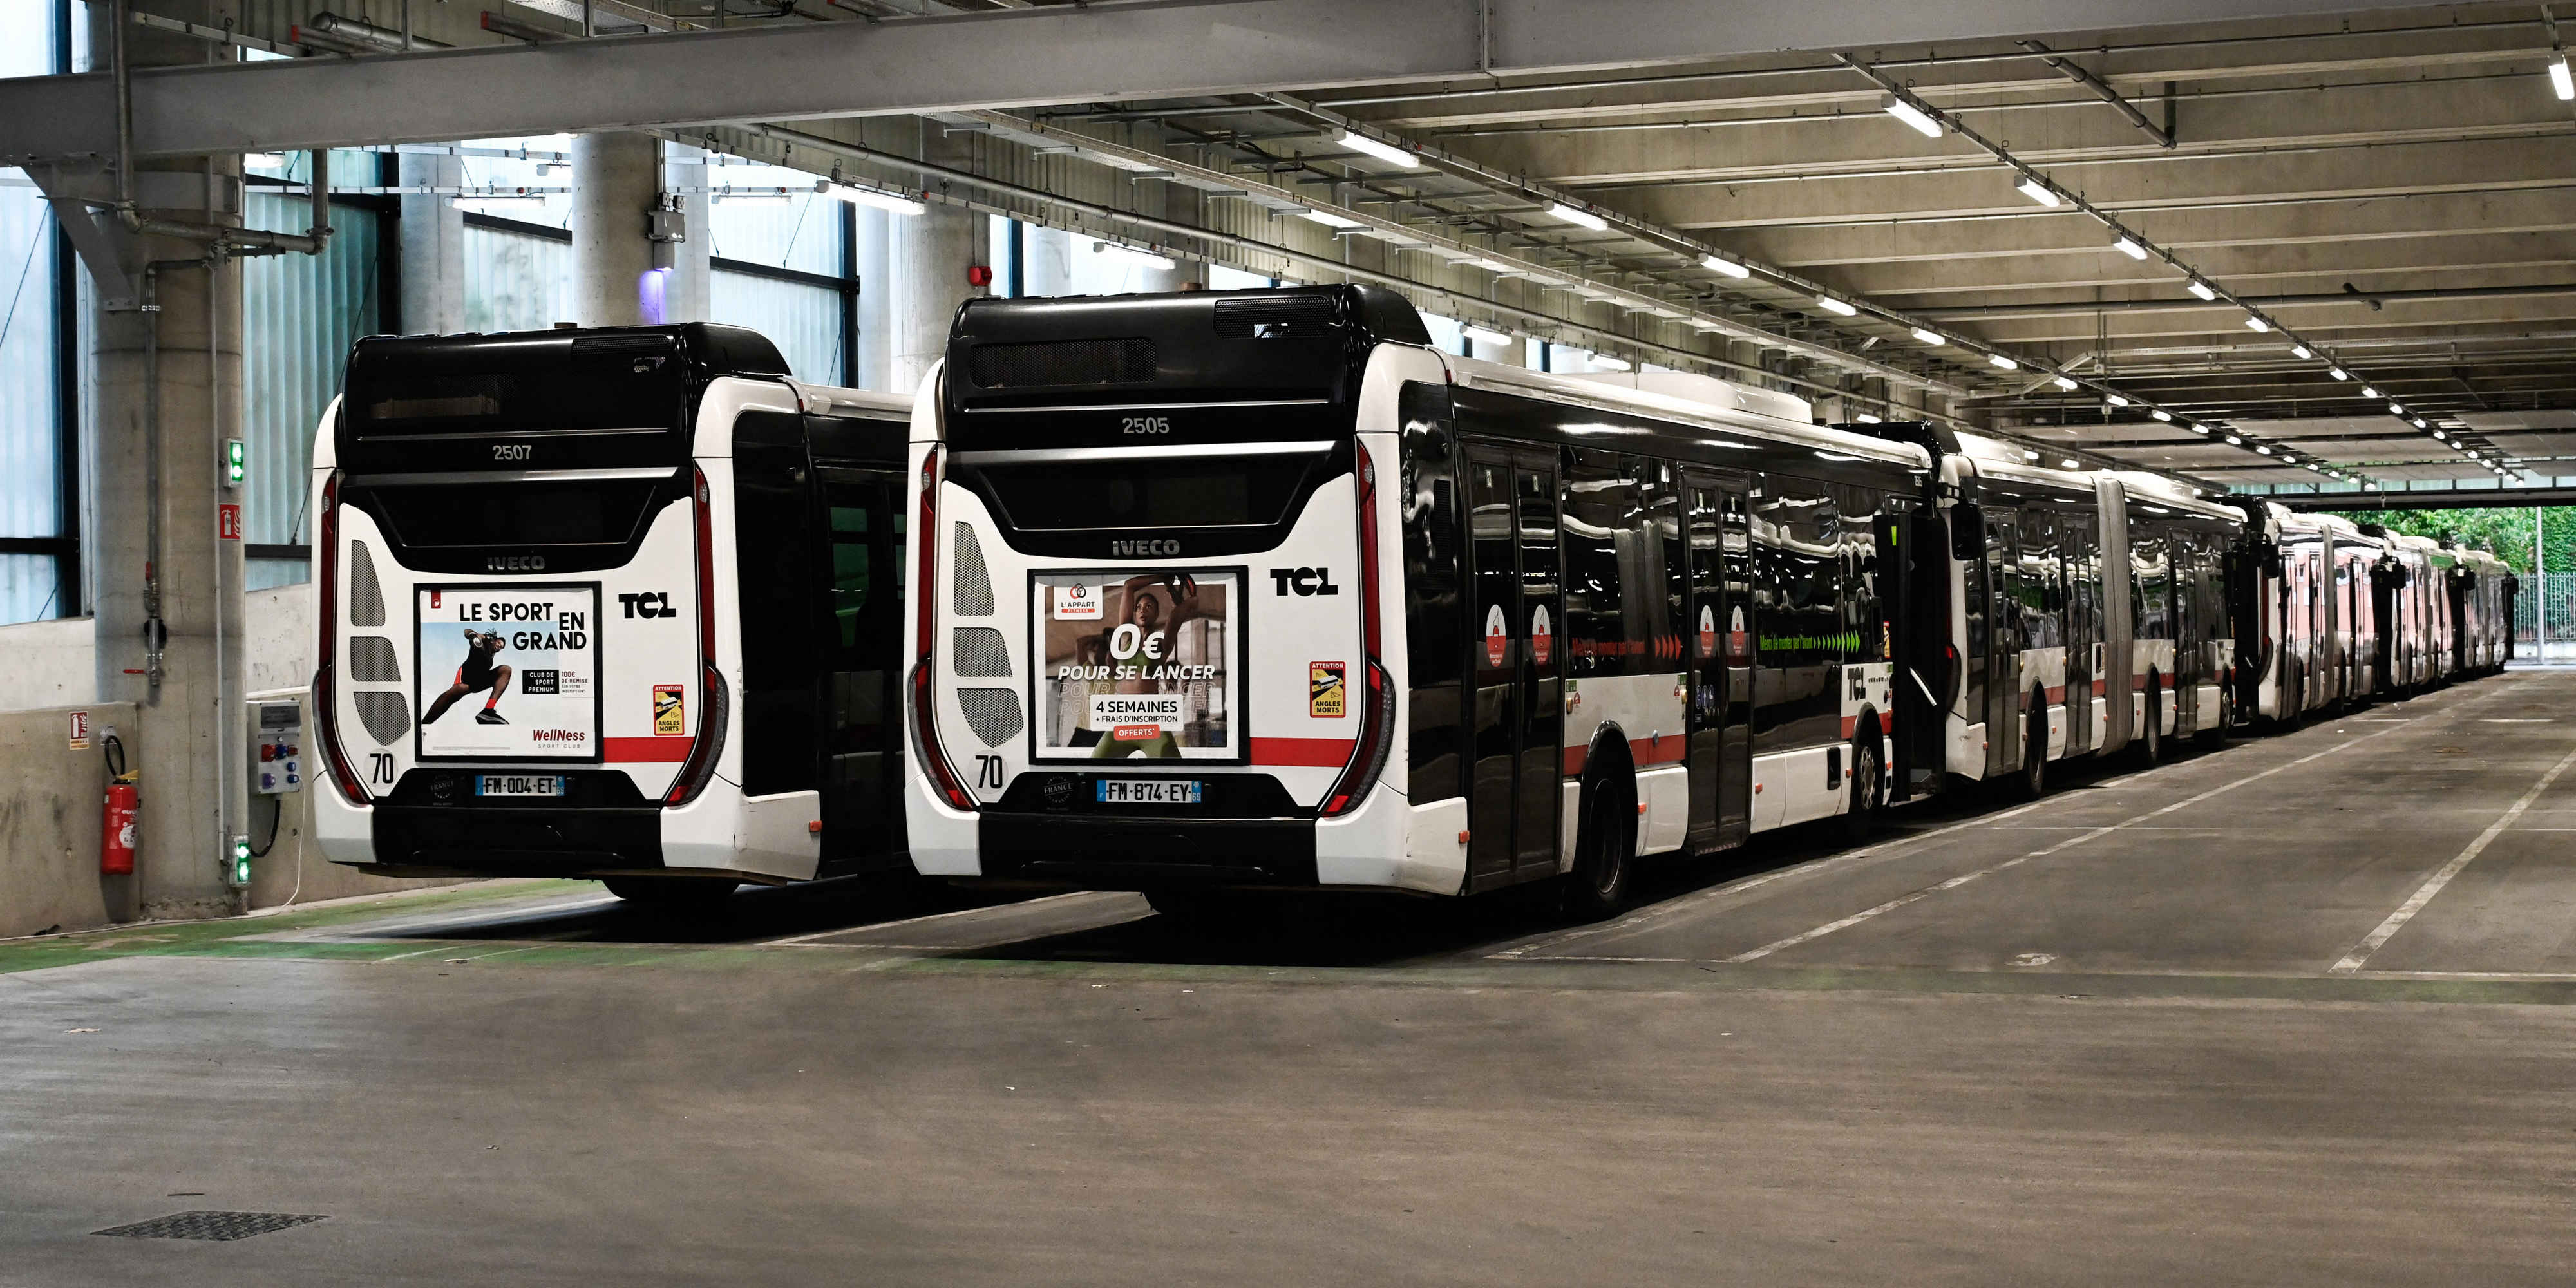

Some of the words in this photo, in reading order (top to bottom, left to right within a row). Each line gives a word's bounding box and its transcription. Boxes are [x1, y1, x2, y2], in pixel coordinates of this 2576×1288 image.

[1122, 417, 1170, 434] 2505
[492, 444, 532, 460] 2507
[1112, 539, 1180, 556] IVECO
[487, 556, 545, 571] IVECO
[1270, 567, 1338, 597] TCL
[459, 603, 482, 621] LE
[489, 603, 553, 621] SPORT
[618, 592, 676, 619] TCL
[559, 612, 585, 630] EN
[513, 631, 587, 650] GRAND
[1110, 623, 1165, 660] 0€
[1057, 665, 1110, 681] POUR
[1113, 665, 1137, 681] SE
[1141, 665, 1216, 681] LANCER
[1848, 667, 1866, 701] TCL
[1095, 701, 1105, 713] 4
[1108, 701, 1178, 713] SEMAINES
[533, 728, 585, 741] WellNess
[370, 753, 393, 784] 70
[975, 755, 1003, 788] 70
[1044, 782, 1072, 794] FRANCE
[1192, 793, 1202, 802] 69
